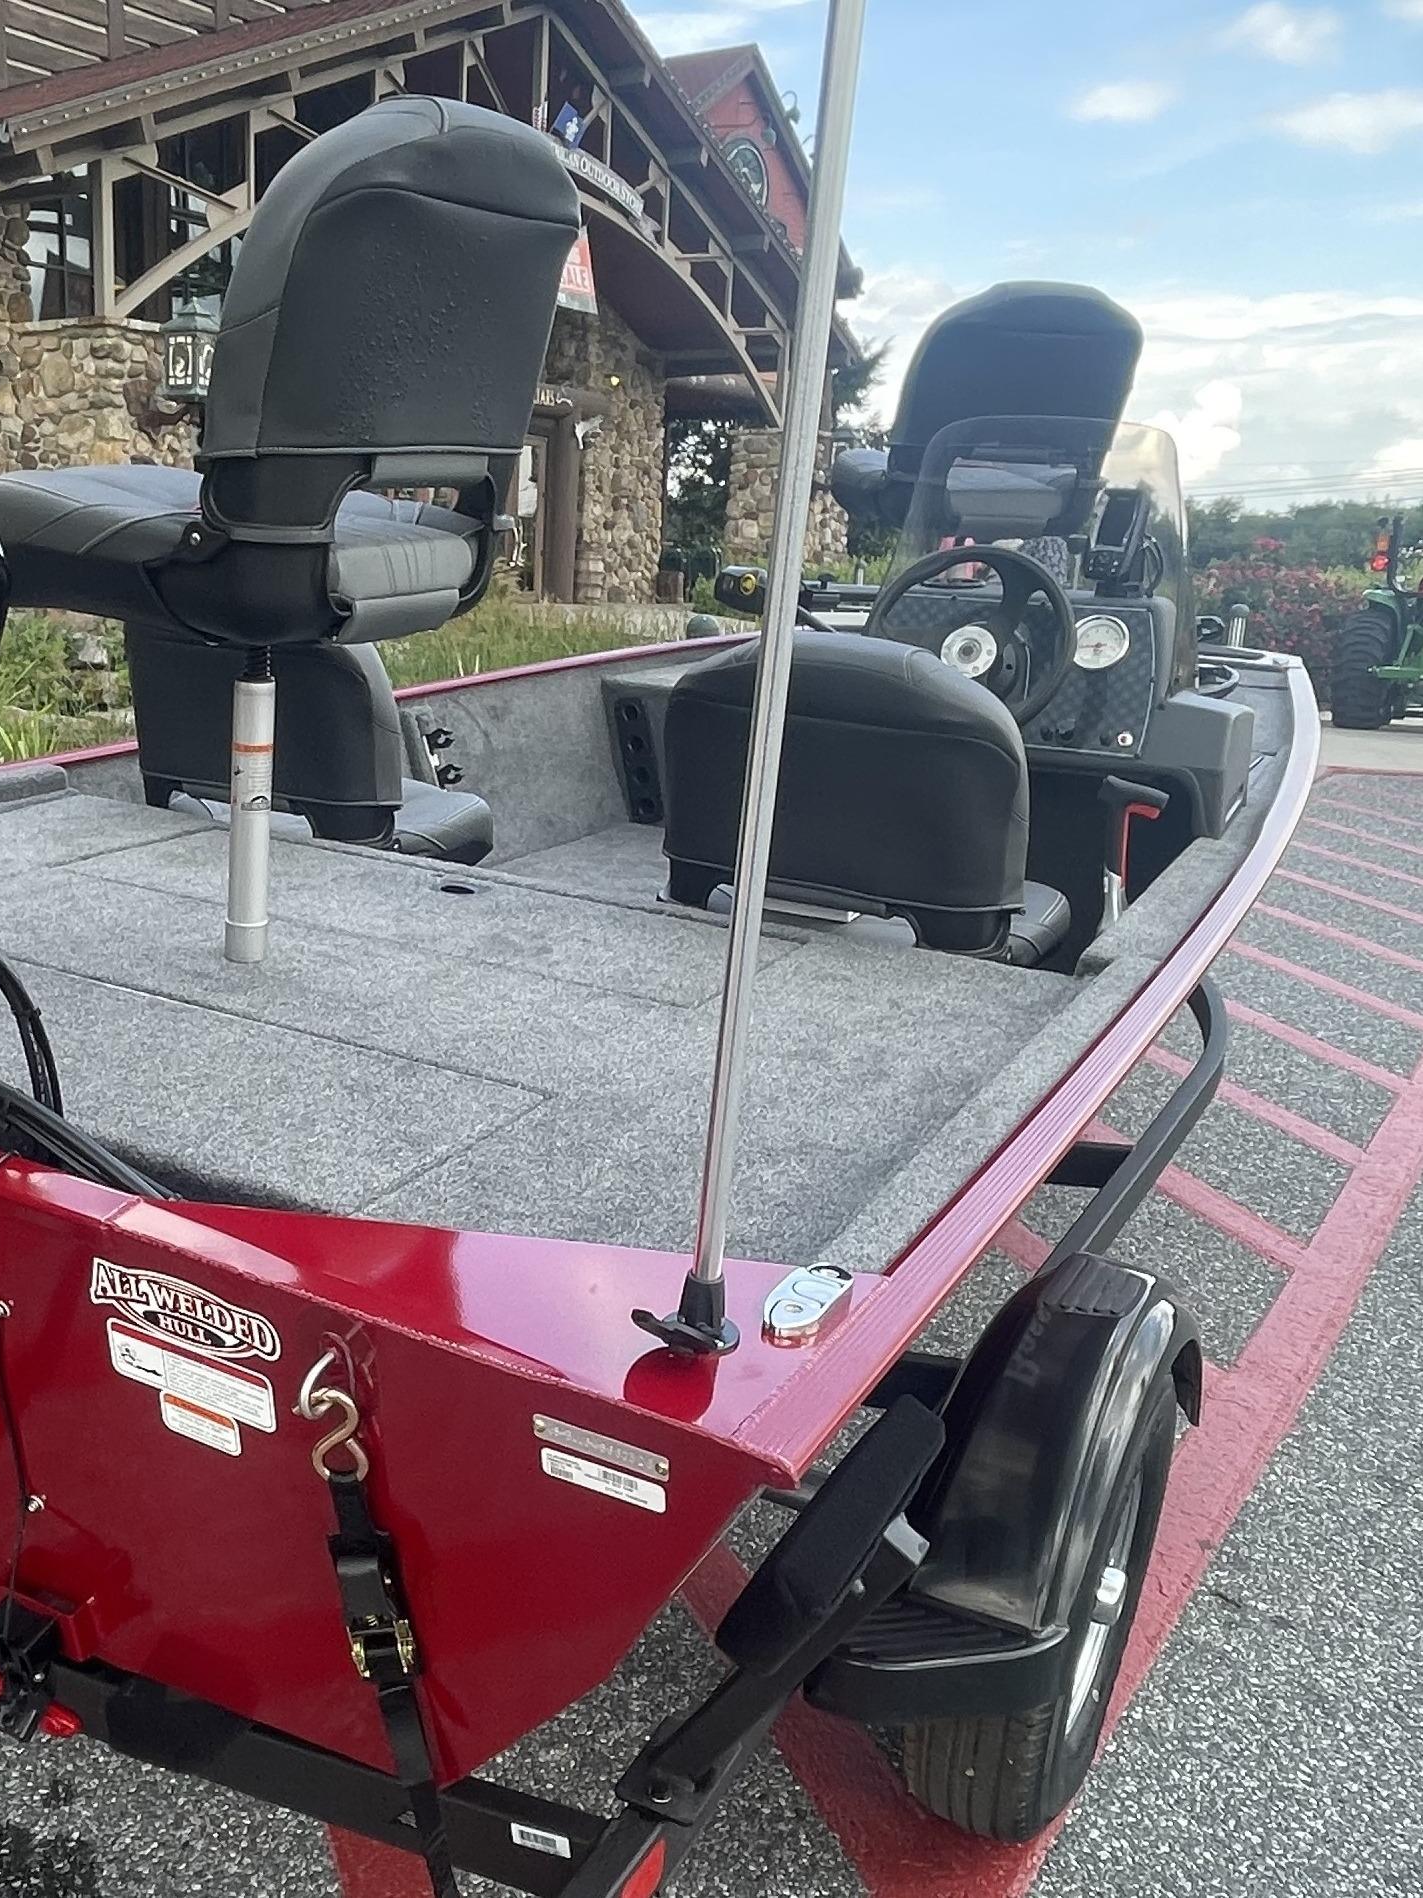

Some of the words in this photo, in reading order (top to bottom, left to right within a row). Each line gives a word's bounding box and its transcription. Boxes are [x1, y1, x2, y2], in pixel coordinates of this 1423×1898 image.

[559, 264, 592, 293] ALE
[95, 1263, 148, 1302] ALL
[148, 1280, 275, 1353] WELDED
[158, 1314, 211, 1345] HULL
